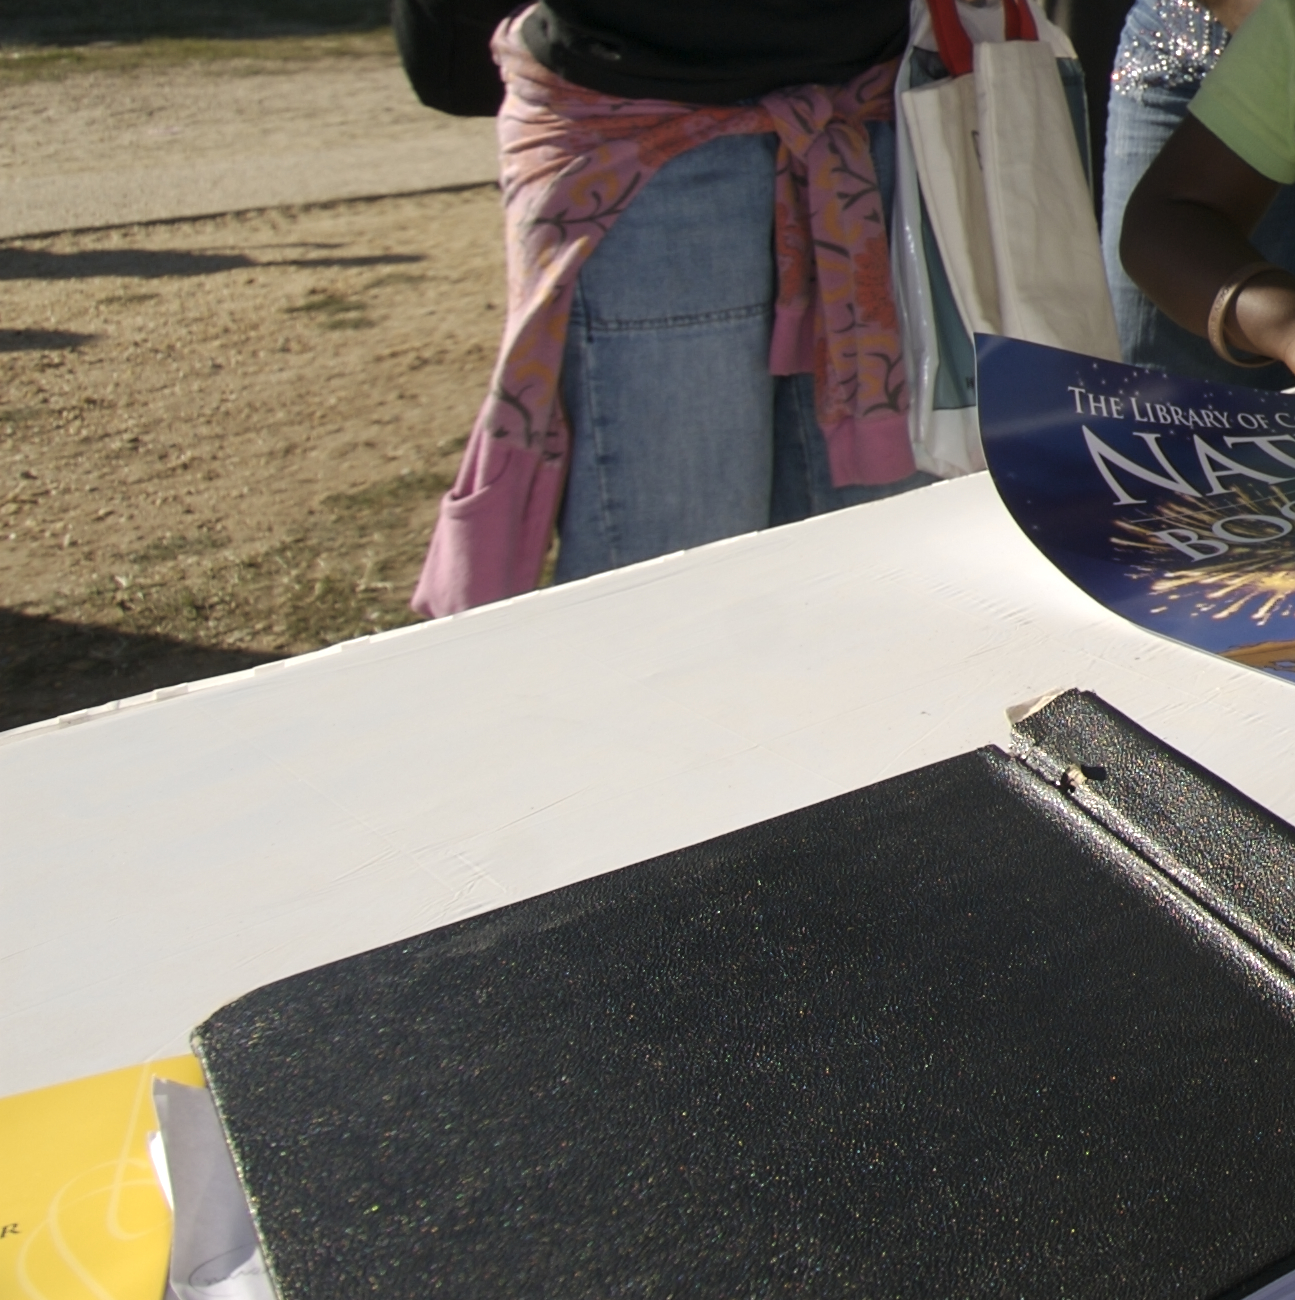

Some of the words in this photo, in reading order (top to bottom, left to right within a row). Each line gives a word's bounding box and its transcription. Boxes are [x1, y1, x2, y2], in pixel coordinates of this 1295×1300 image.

[1068, 386, 1125, 420] THE
[1130, 397, 1231, 430] LIBRARY
[1237, 413, 1271, 431] OF
